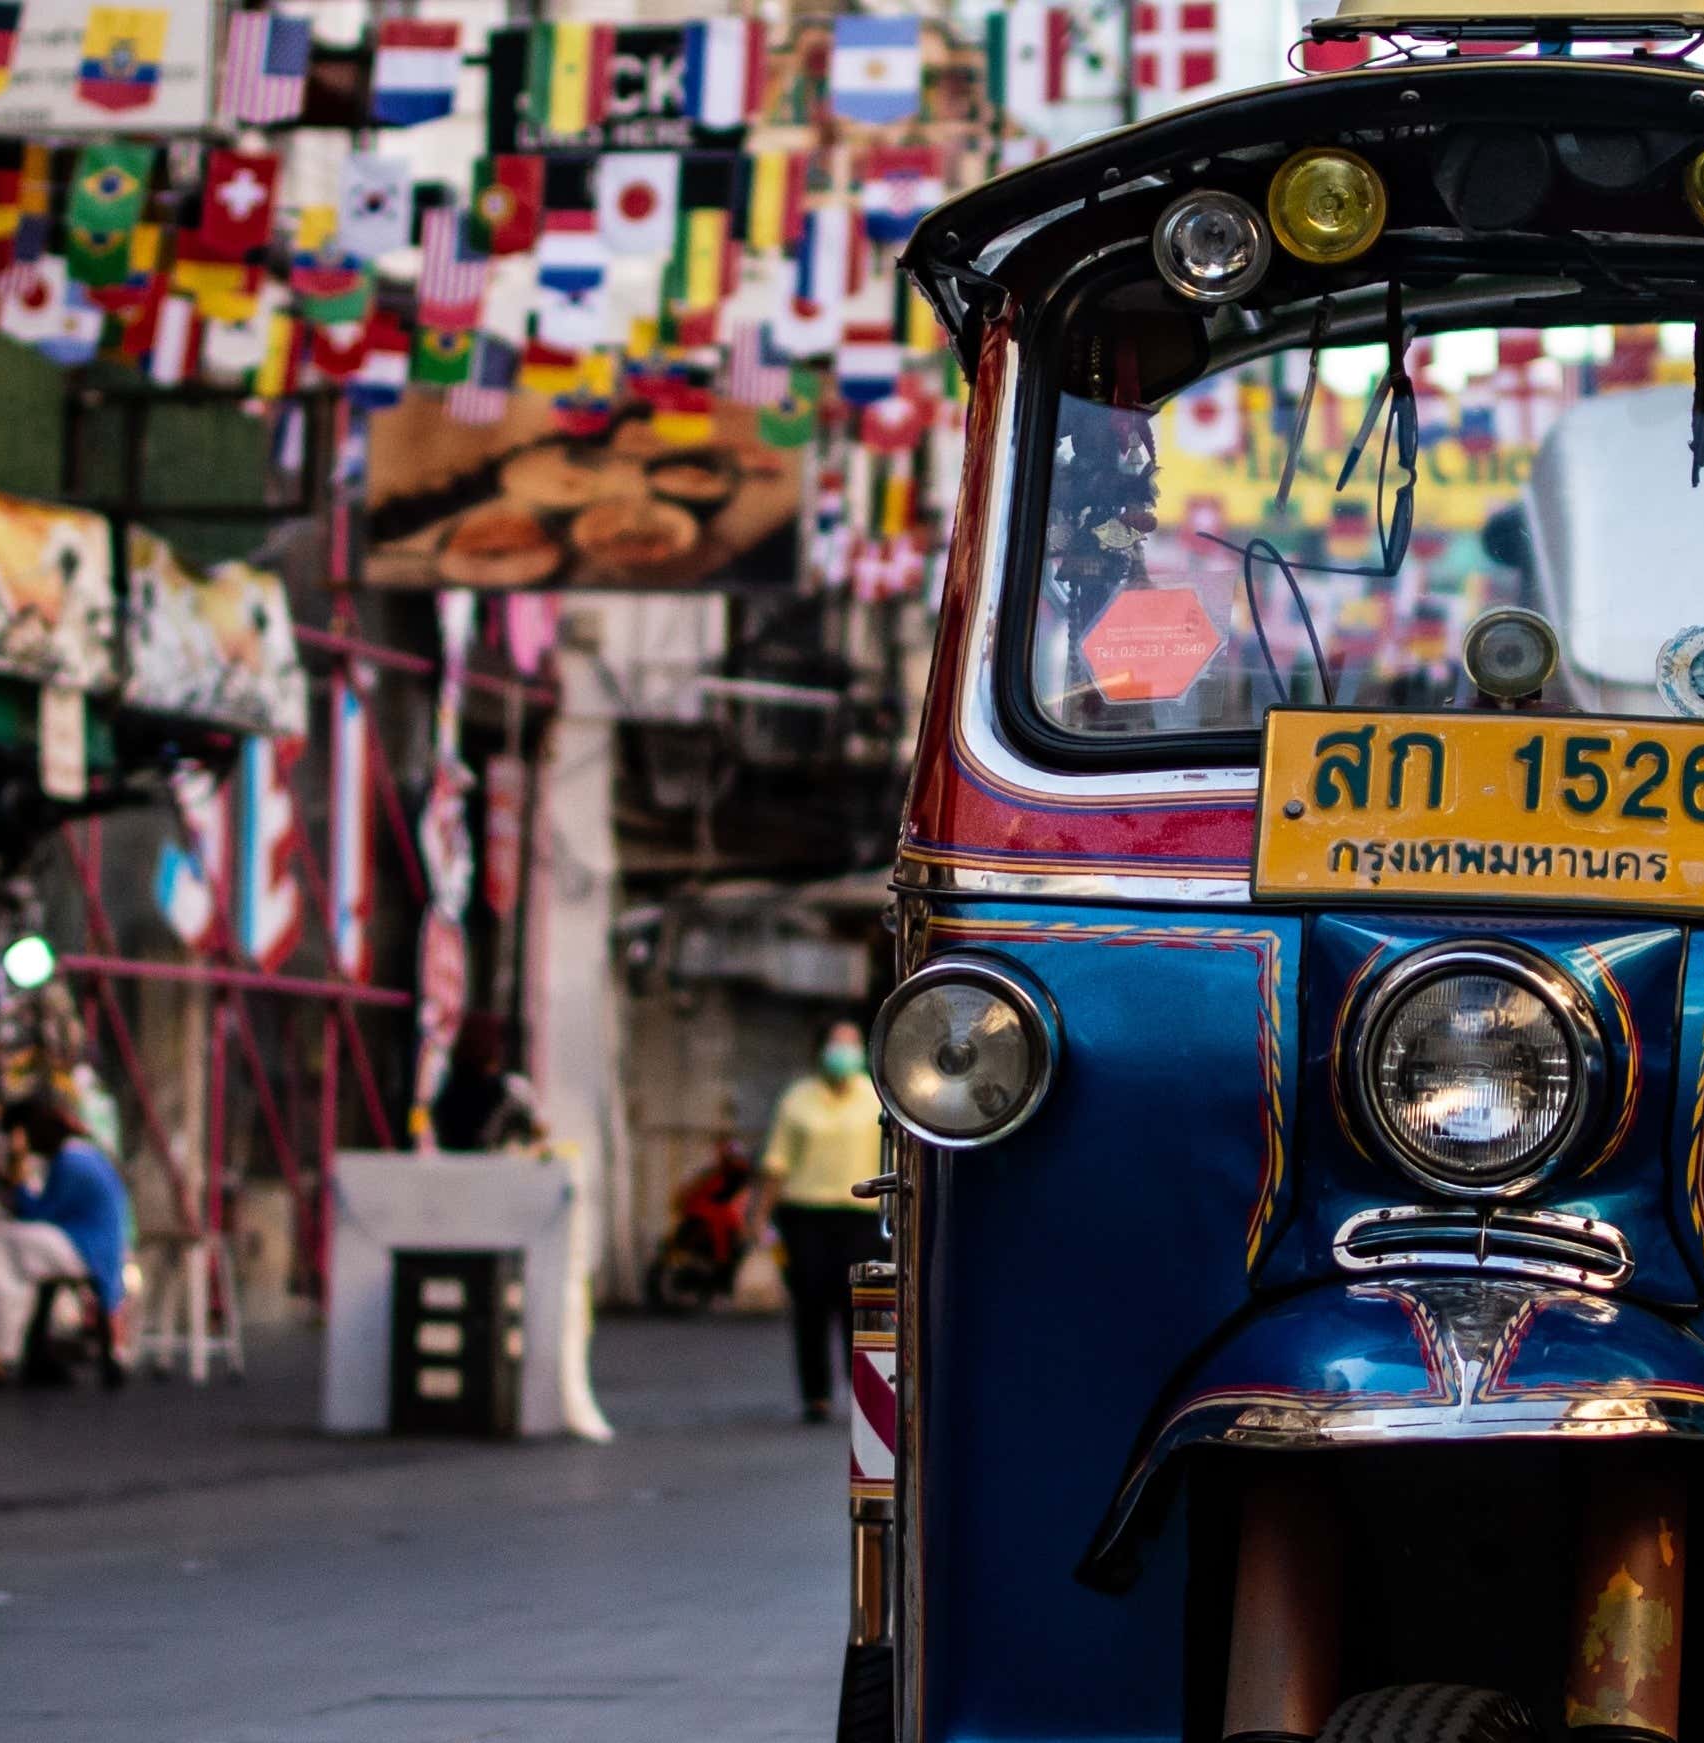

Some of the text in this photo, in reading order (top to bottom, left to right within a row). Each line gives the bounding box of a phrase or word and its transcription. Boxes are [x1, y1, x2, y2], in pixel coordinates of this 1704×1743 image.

[1313, 724, 1447, 810] สก
[1330, 840, 1669, 885] กรุงเทพมหานคร
